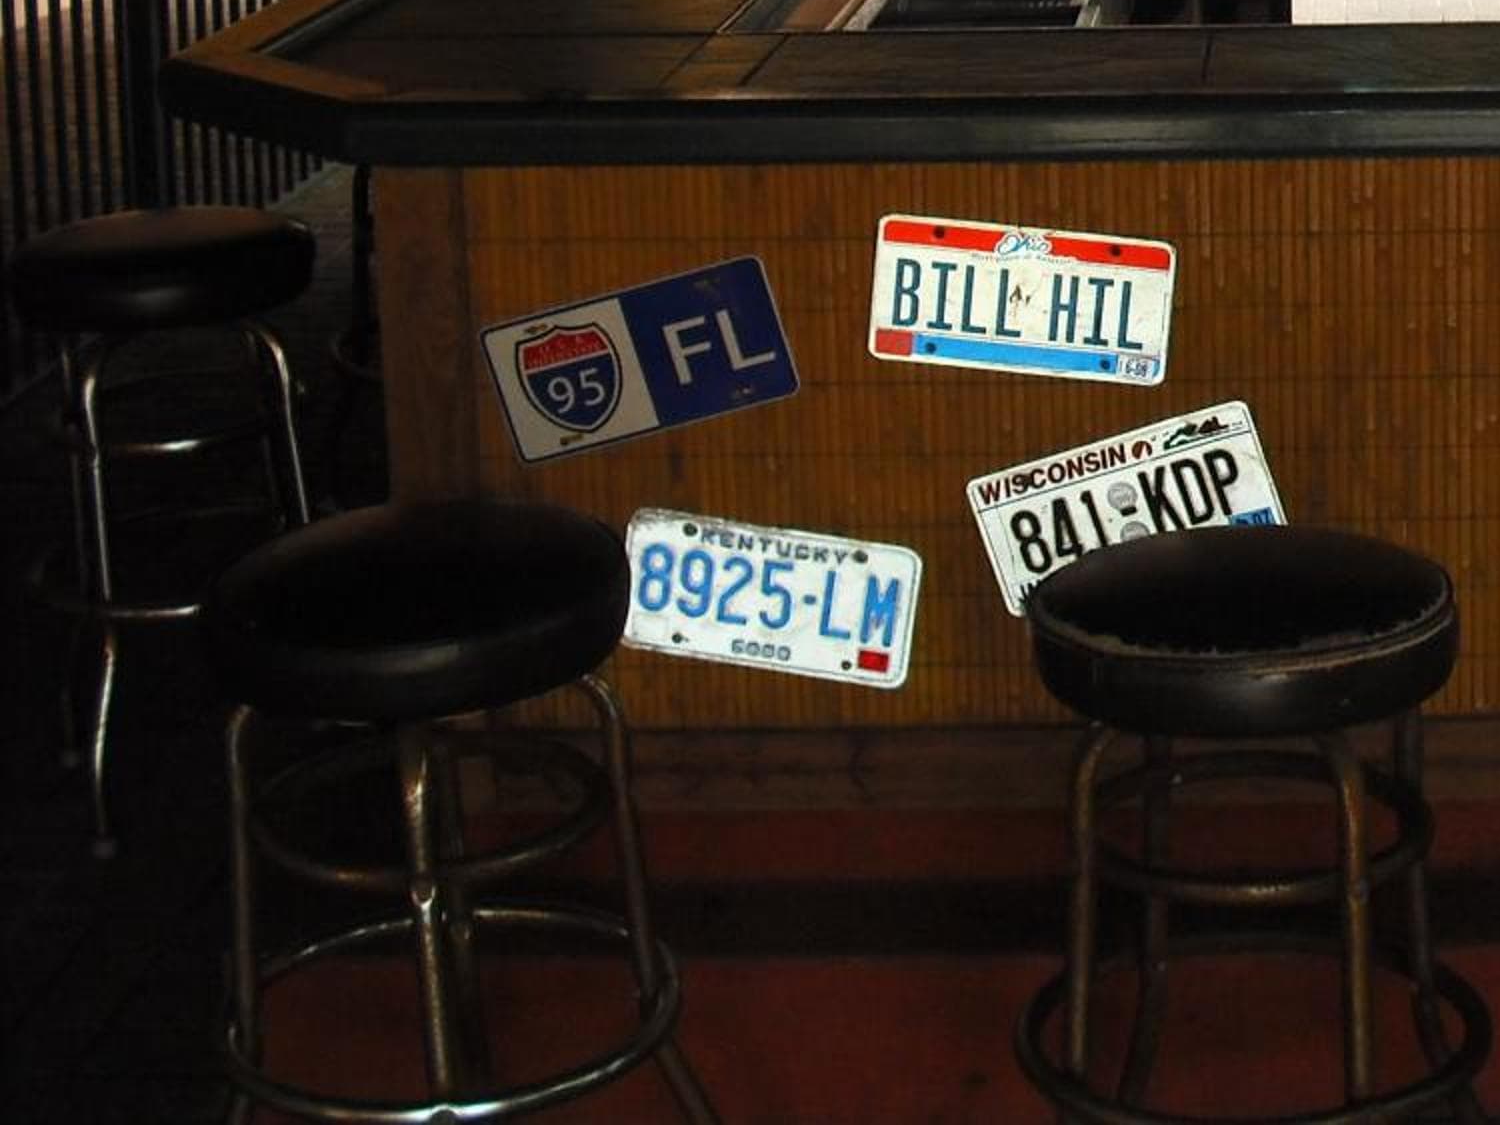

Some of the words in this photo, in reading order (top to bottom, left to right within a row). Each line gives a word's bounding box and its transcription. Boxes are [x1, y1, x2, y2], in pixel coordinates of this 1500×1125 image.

[892, 258, 1022, 338] BILL
[1049, 273, 1143, 350] HIL
[661, 308, 777, 385] FL
[546, 367, 607, 414] 95
[977, 443, 1127, 505] WISCONSIN
[700, 527, 849, 565] KENTUCKY
[637, 542, 899, 648] 8925-LM
